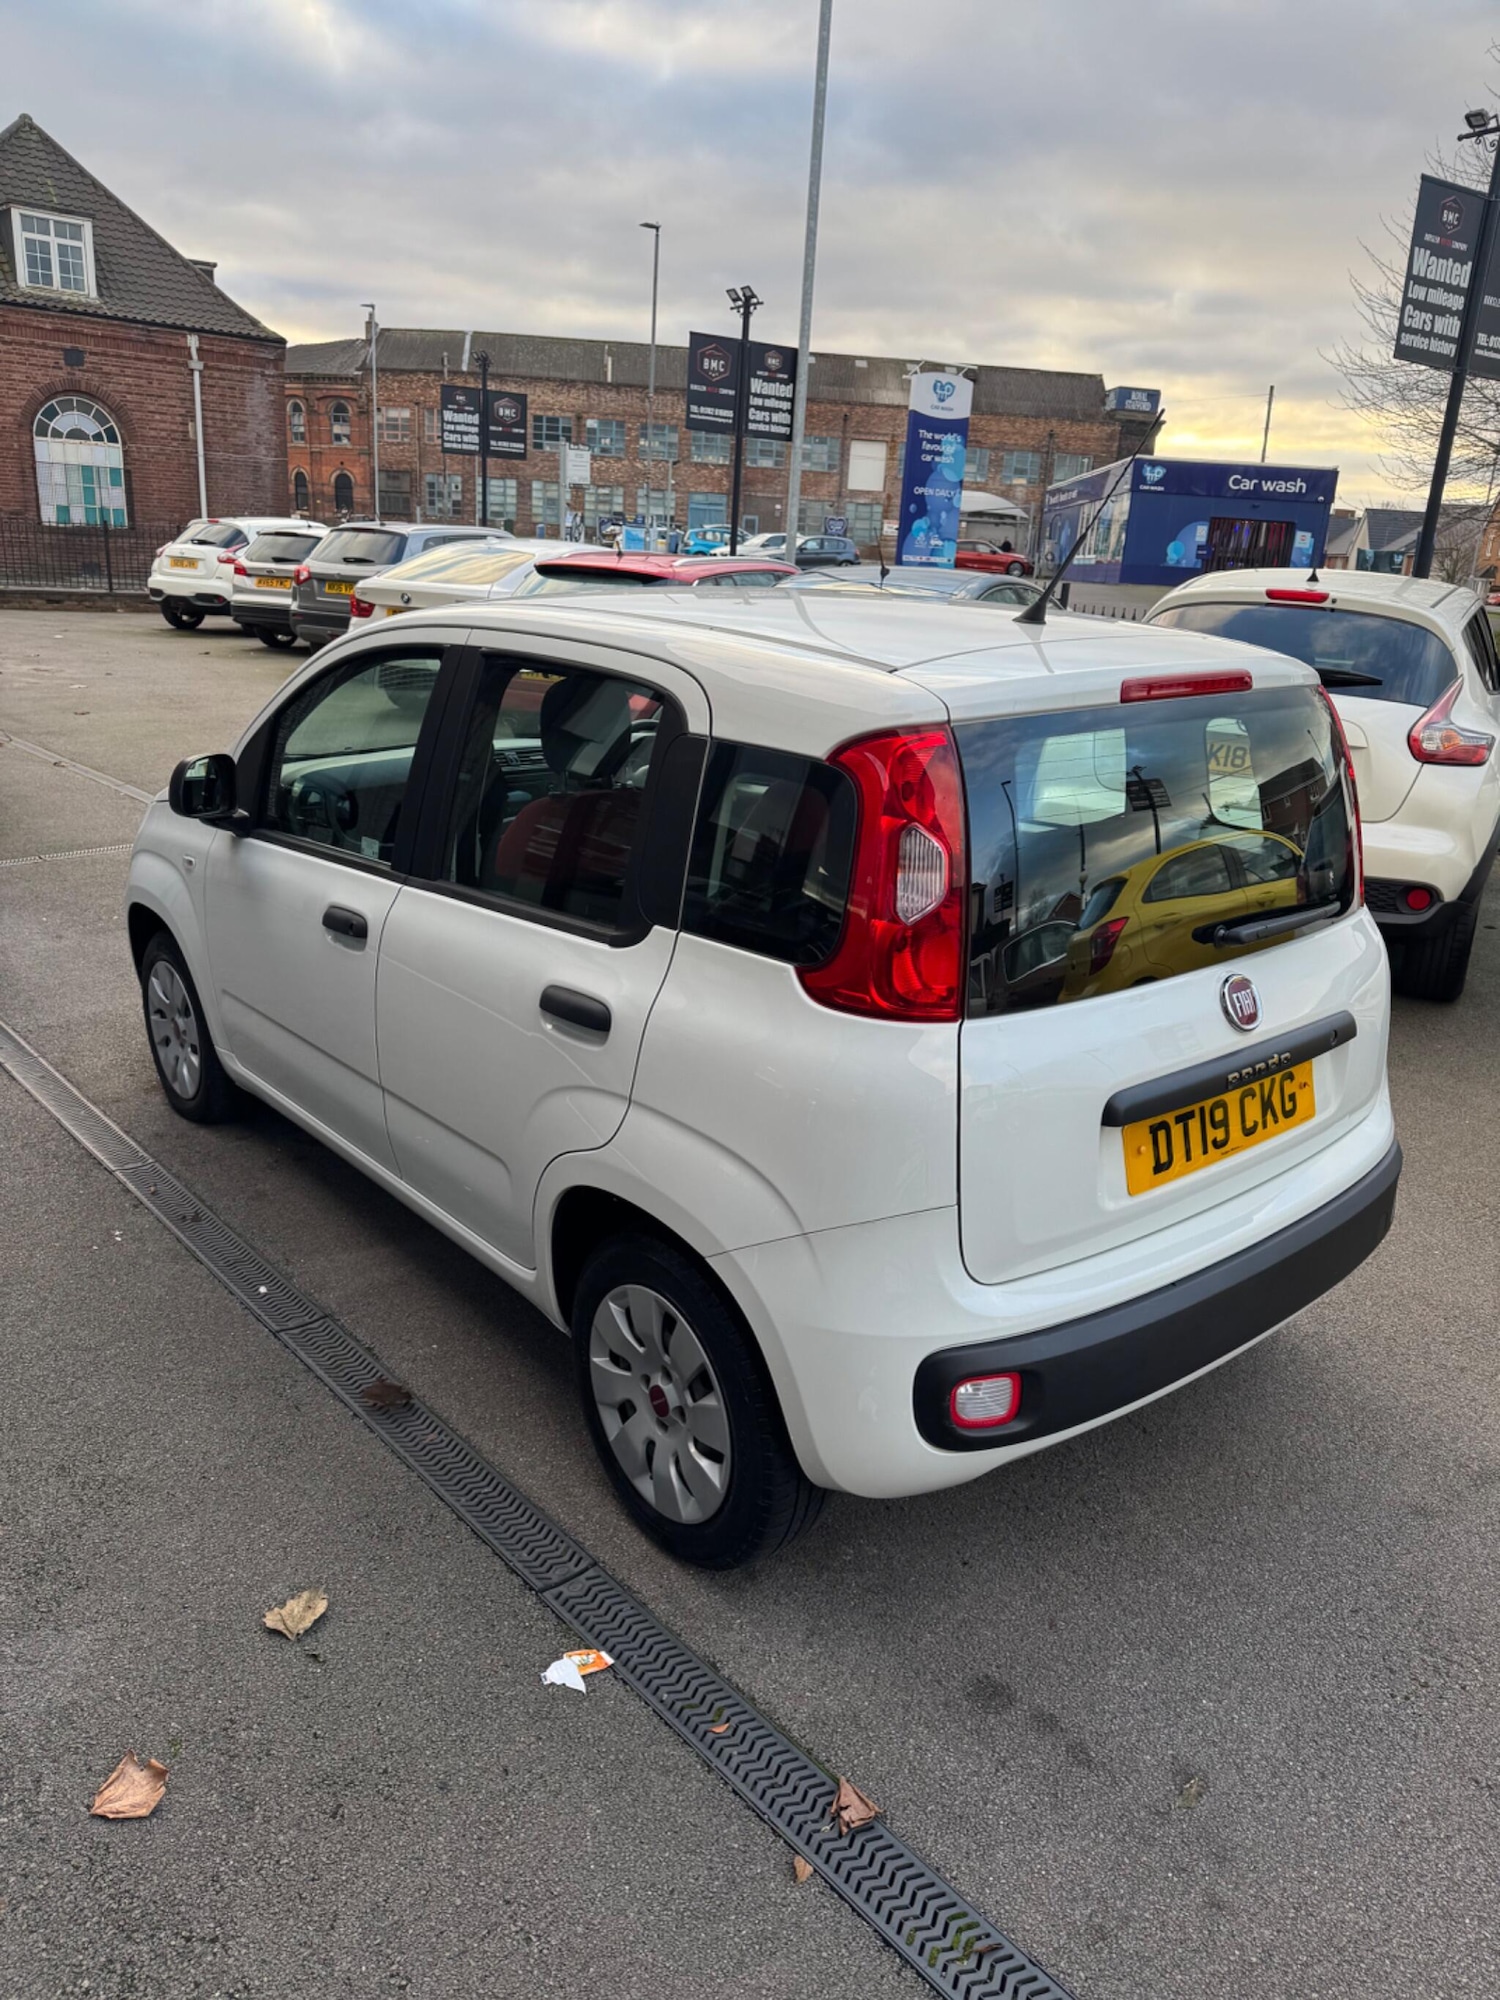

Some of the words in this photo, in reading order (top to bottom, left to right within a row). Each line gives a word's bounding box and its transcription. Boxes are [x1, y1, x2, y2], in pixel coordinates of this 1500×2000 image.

[1442, 209, 1460, 225] BMC
[1412, 246, 1473, 288] Wanted
[1407, 280, 1428, 301] Low
[1427, 287, 1465, 311] mileage
[1403, 304, 1433, 332] Cars
[1434, 314, 1461, 338] with
[1400, 332, 1429, 350] service
[1429, 336, 1458, 358] history
[703, 358, 726, 372] BMC
[750, 378, 794, 398] Wanted
[749, 395, 763, 406] Low
[764, 398, 792, 410] mileage
[443, 410, 479, 425] Wanted
[498, 407, 516, 417] BMC
[748, 407, 770, 422] Cars
[771, 411, 791, 425] with
[443, 422, 455, 431] Low
[455, 424, 479, 434] mileage
[748, 423, 770, 432] service
[770, 424, 791, 436] history
[918, 429, 932, 439] The
[934, 432, 961, 442] world's
[443, 431, 461, 442] Cars
[462, 434, 479, 444] with
[934, 455, 955, 464] wash
[1228, 475, 1259, 490] Car
[1261, 478, 1307, 493] wash
[913, 486, 934, 496] OPEN
[935, 488, 956, 498] DAILY
[1232, 989, 1257, 1017] FIAT
[1149, 1098, 1230, 1175] DT19
[1239, 1071, 1298, 1137] CKG
